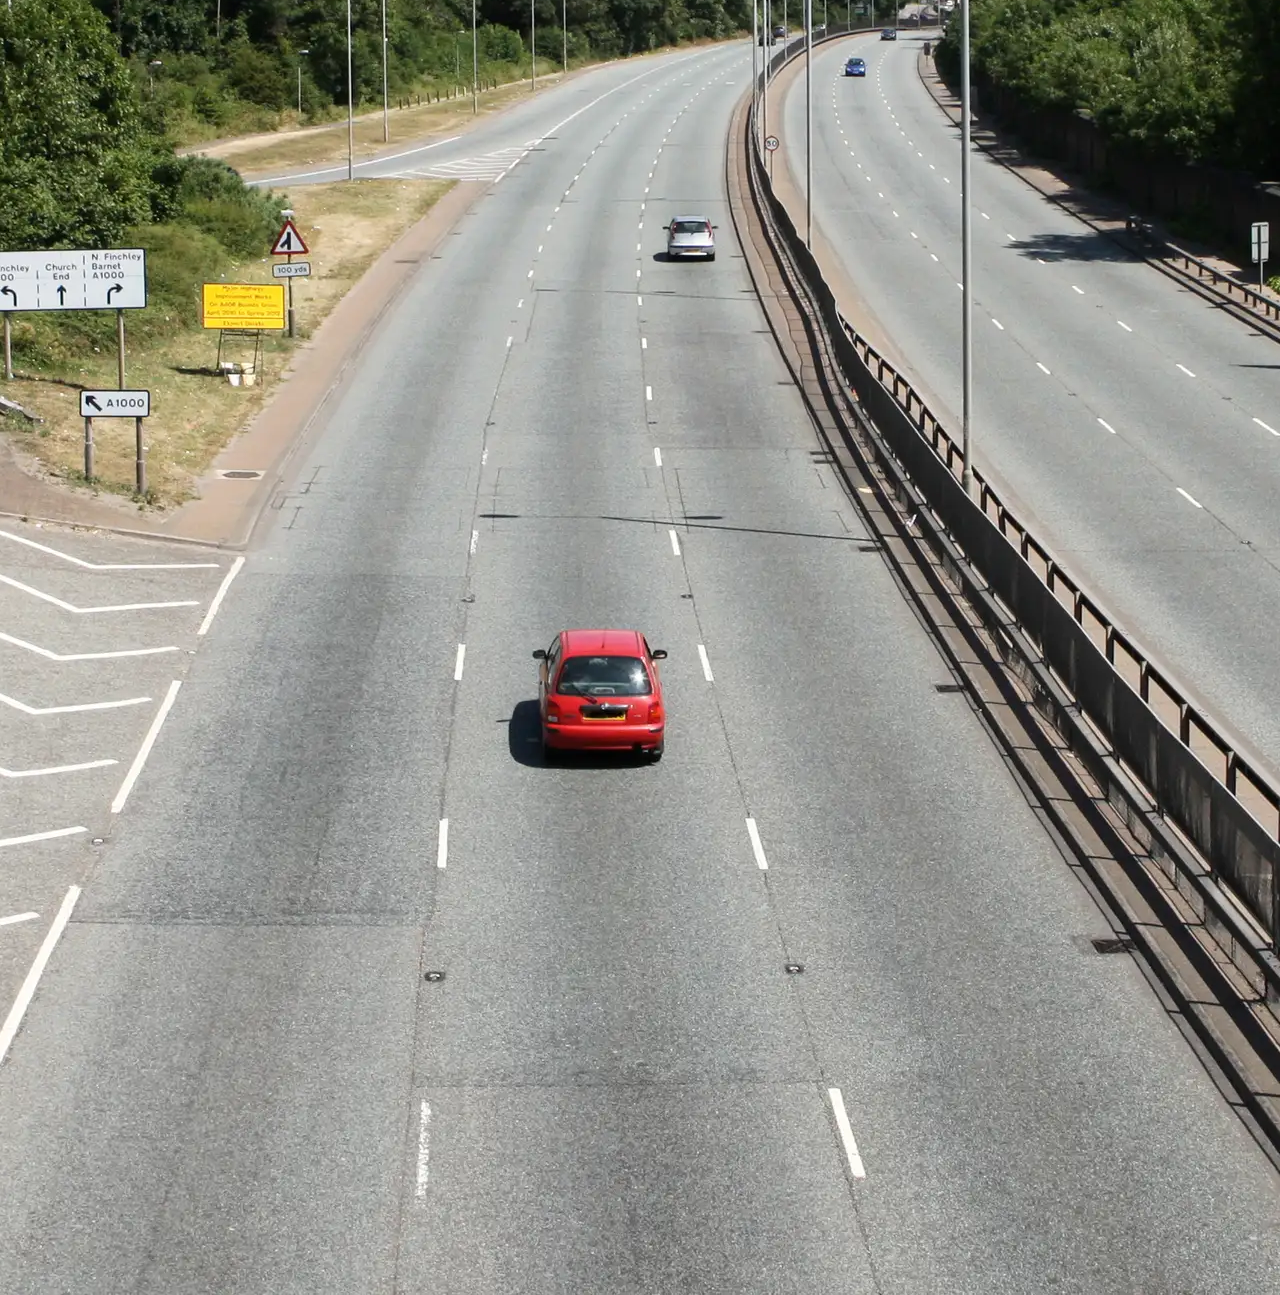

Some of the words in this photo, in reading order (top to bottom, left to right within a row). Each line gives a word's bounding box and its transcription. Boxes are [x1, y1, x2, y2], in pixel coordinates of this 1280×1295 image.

[104, 253, 141, 261] Finchley
[45, 263, 77, 271] Church
[91, 262, 121, 270] Barnet
[294, 266, 307, 274] yds
[106, 398, 145, 408] A1000
